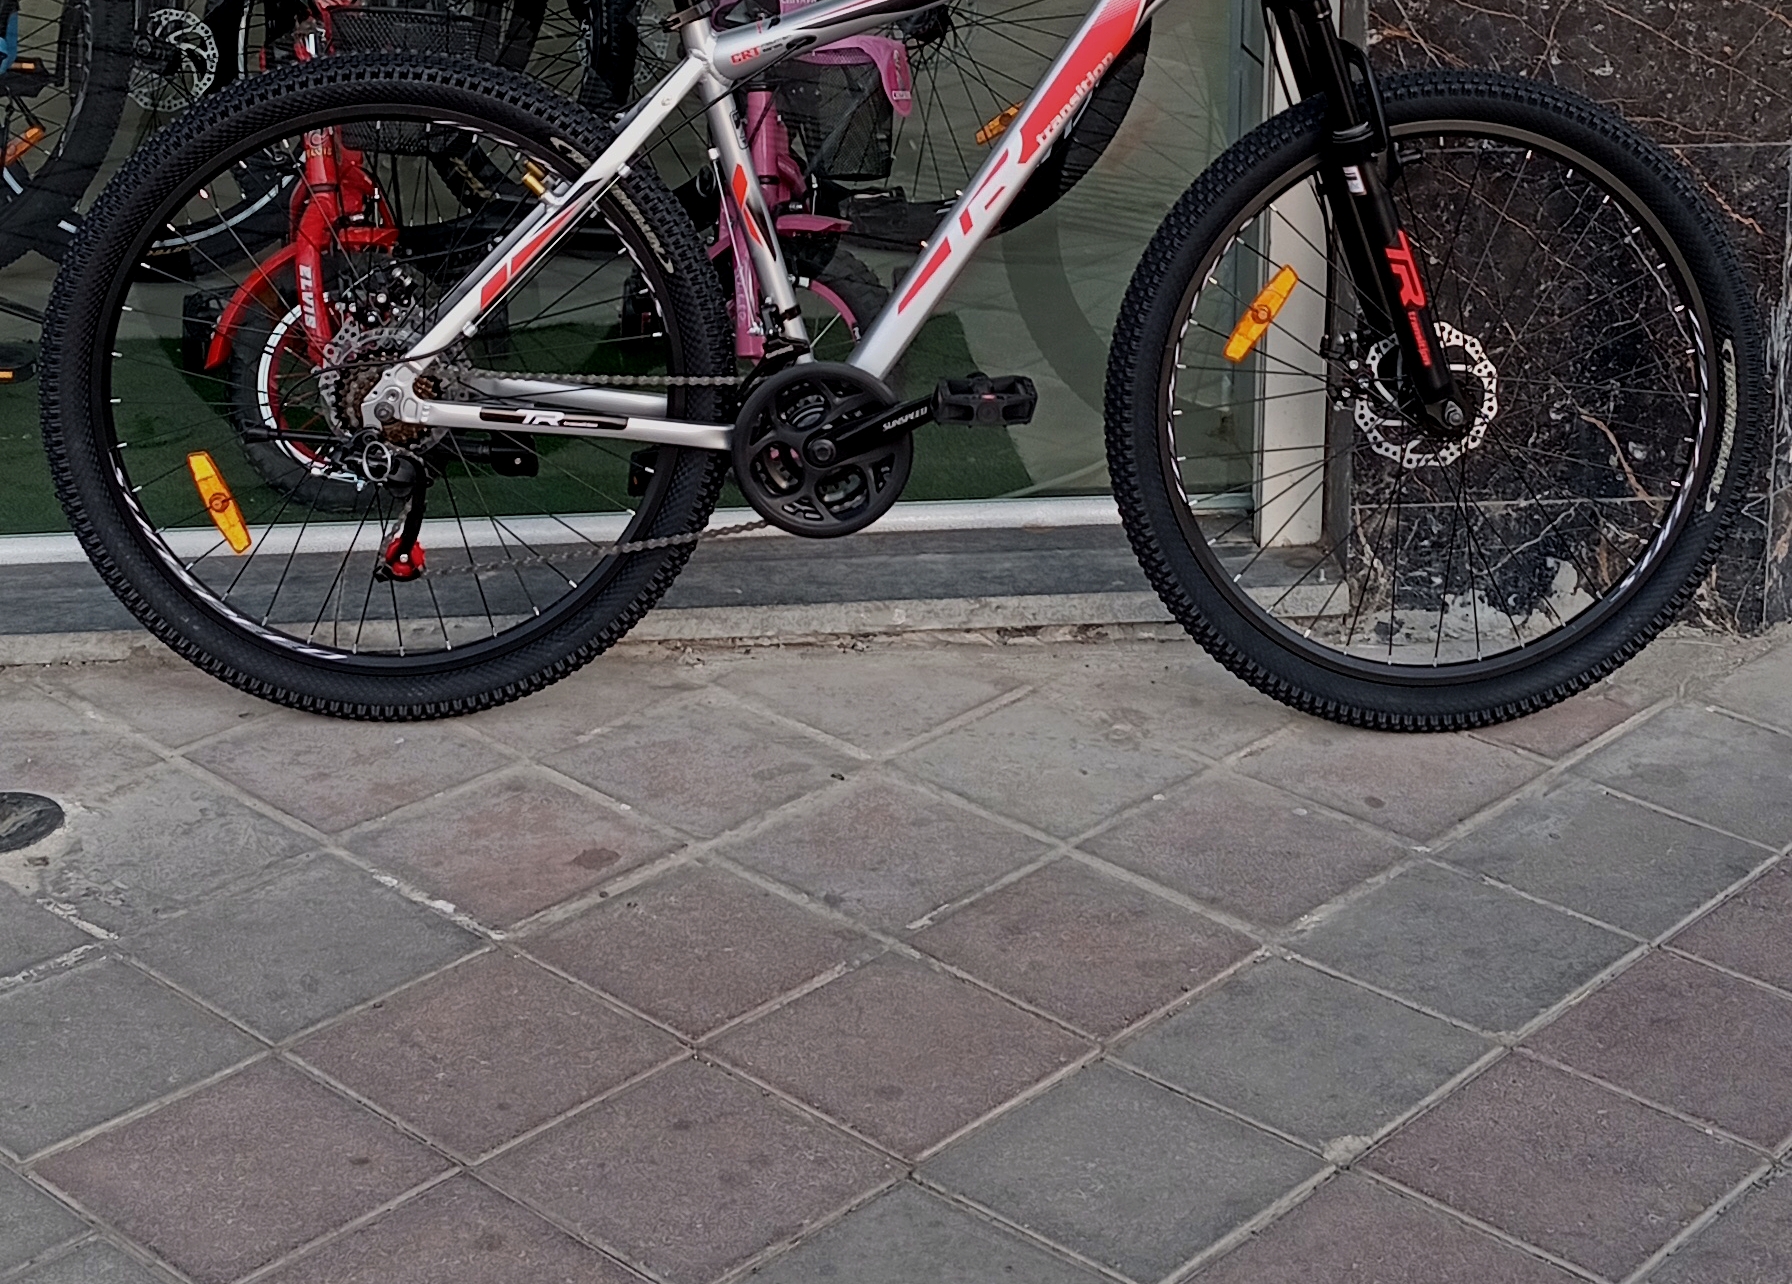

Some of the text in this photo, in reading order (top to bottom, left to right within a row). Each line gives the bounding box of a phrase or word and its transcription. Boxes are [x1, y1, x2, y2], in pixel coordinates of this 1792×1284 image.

[1035, 51, 1116, 147] transition
[299, 264, 317, 329] ELVIS
[1384, 229, 1433, 368] TR transition
[515, 408, 565, 426] TR
